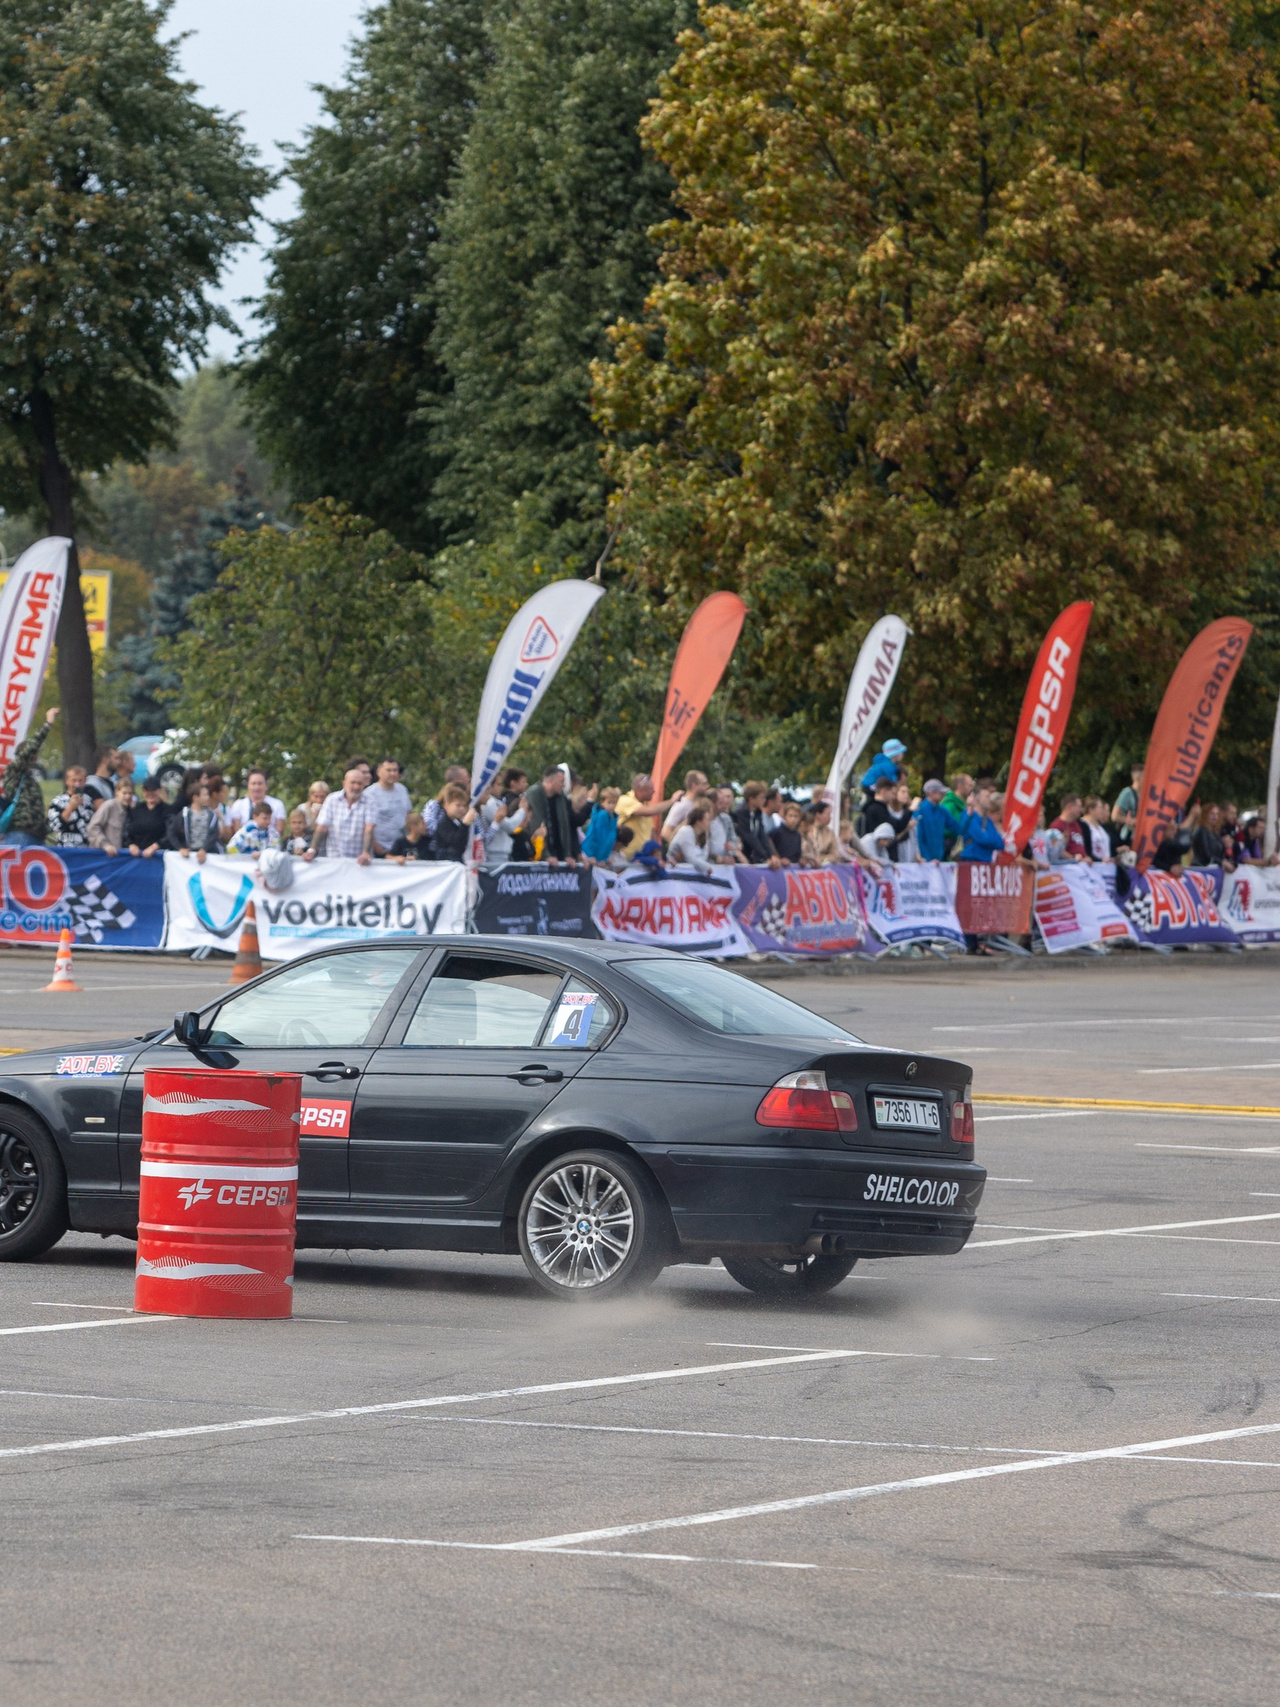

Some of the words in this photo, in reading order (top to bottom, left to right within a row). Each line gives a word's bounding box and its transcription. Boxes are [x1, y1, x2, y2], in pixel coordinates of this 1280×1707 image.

[1013, 636, 1071, 807] CEPSA
[1168, 634, 1243, 788] lubricants
[970, 864, 1022, 896] BELARUS
[784, 869, 849, 927] АВТО
[600, 895, 734, 935] NAKAYAMA
[562, 1009, 584, 1040] 4
[57, 1055, 121, 1074] ADT.BY
[884, 1101, 912, 1123] 7356
[217, 1185, 289, 1206] CEPSA
[863, 1173, 960, 1207] SHELCOLOR
